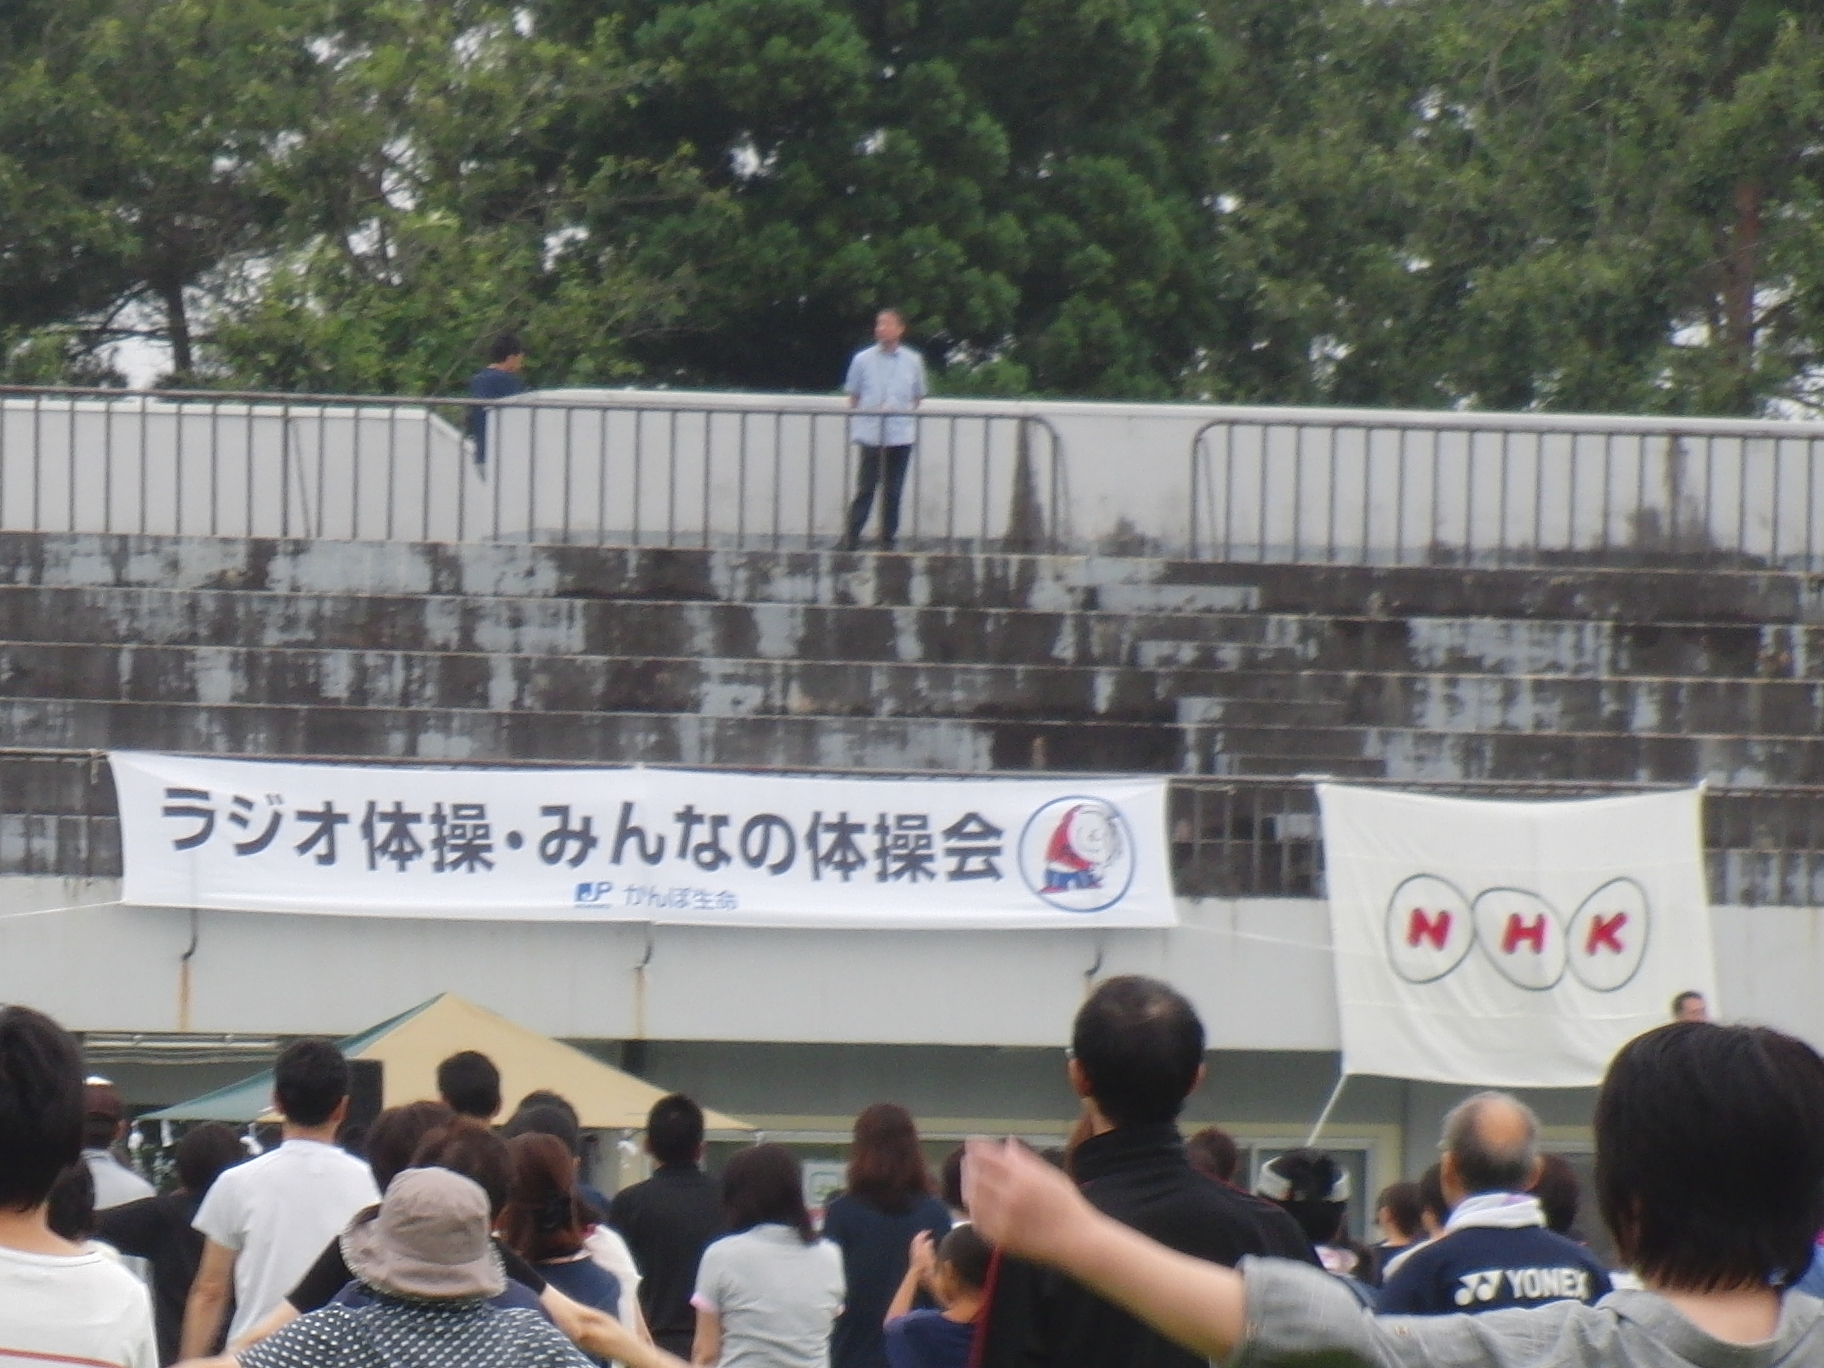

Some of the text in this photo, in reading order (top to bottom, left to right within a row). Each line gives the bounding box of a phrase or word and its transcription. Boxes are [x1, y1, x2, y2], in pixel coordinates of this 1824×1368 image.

[161, 787, 1005, 883] ラジオ体操・みんなの体操会
[1407, 907, 1629, 956] NHK
[1505, 1267, 1590, 1300] YONEX
